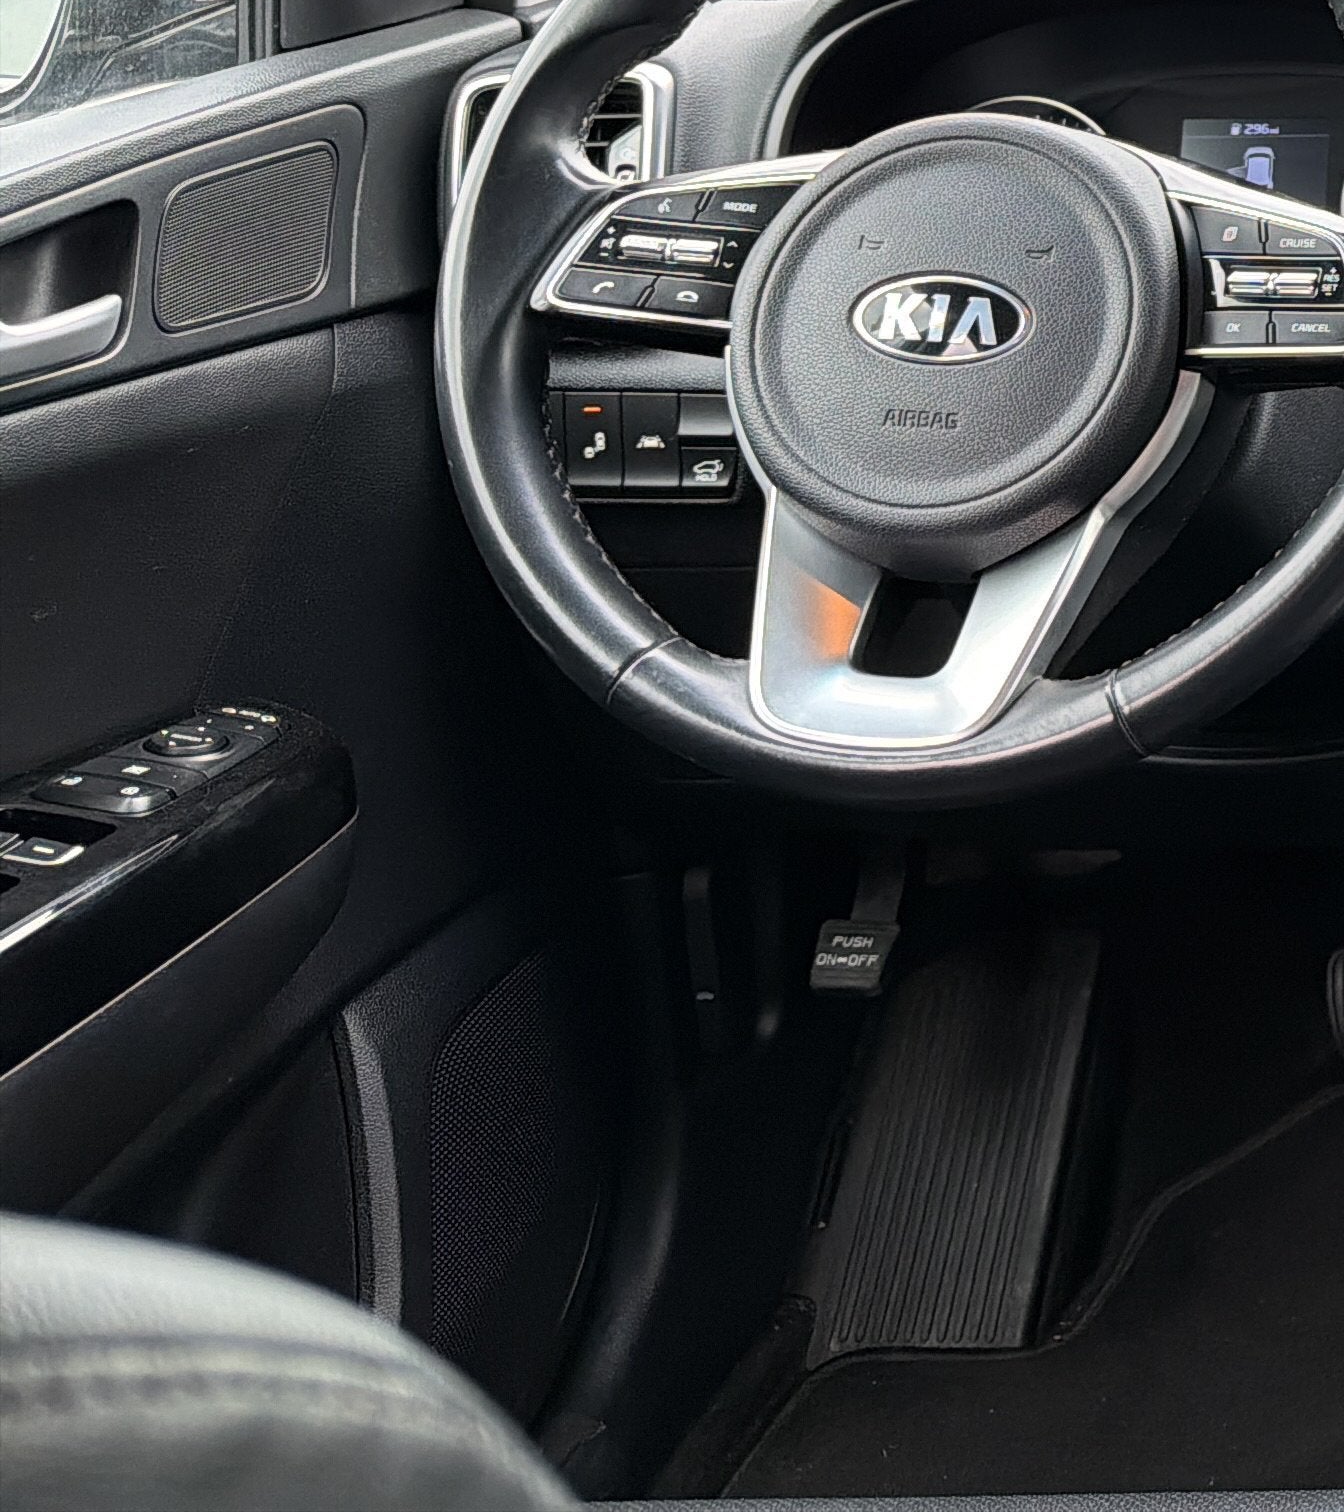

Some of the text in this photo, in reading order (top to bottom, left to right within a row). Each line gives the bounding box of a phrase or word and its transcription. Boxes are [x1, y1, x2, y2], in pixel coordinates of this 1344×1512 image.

[723, 202, 758, 213] MODE
[1279, 238, 1317, 248] CRUISE
[878, 292, 997, 345] KIA
[1226, 322, 1241, 333] OK
[1291, 322, 1331, 333] CANCEL
[882, 408, 959, 429] AIRBAG
[832, 936, 874, 948] PUSH
